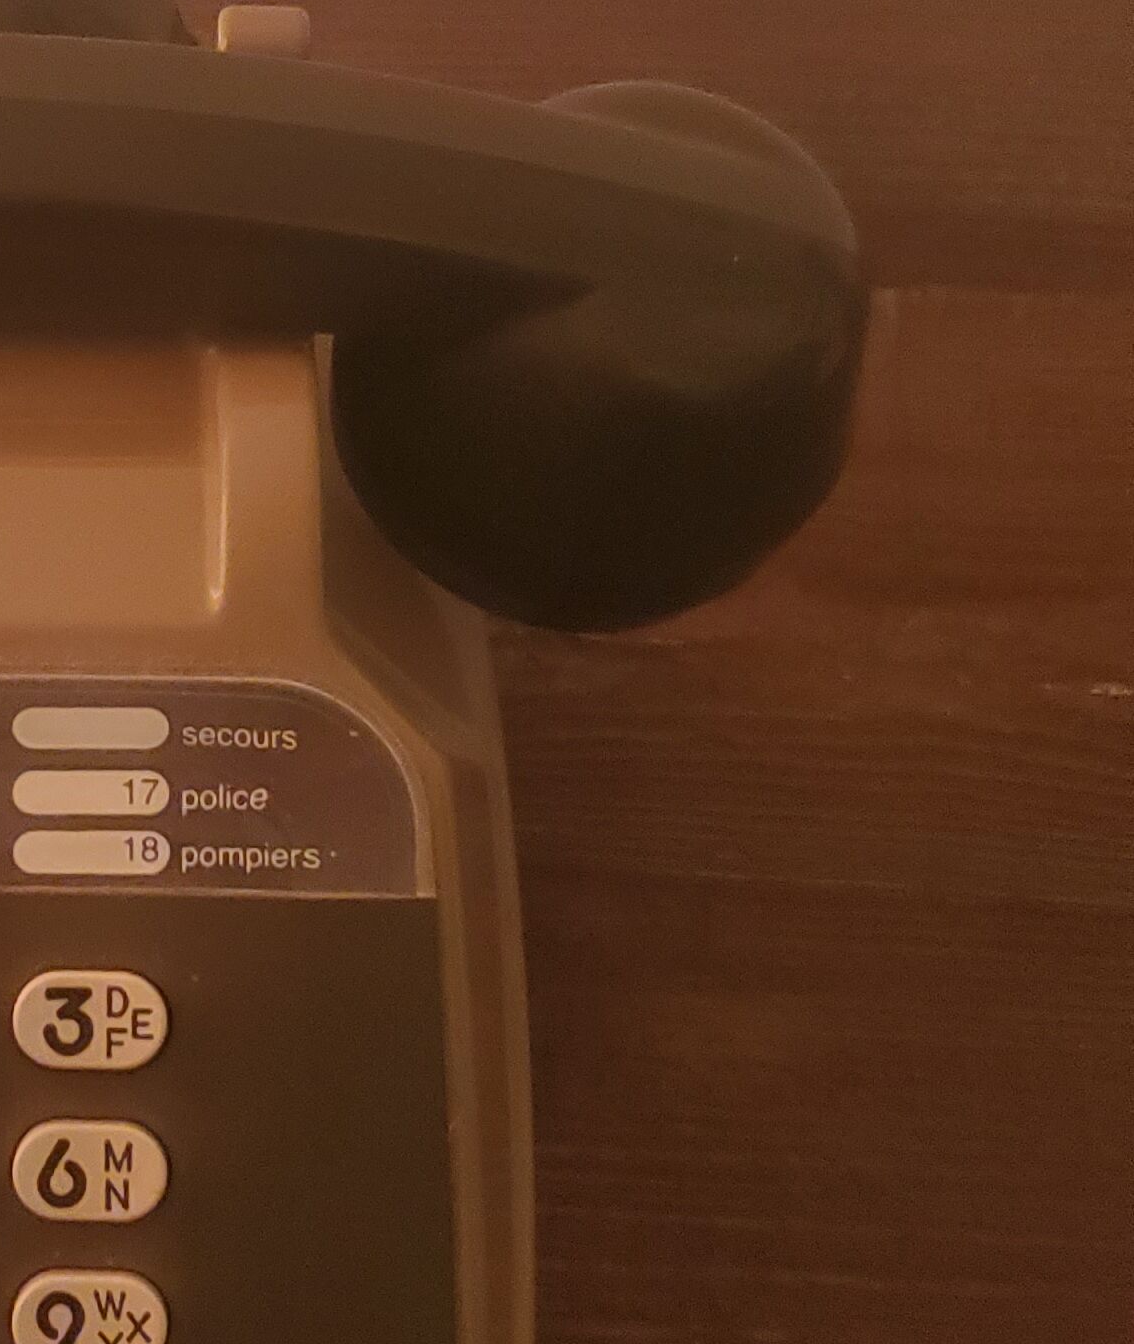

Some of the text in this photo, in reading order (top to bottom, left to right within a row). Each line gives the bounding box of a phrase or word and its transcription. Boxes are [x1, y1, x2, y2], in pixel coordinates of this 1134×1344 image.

[181, 725, 298, 750] secours
[123, 779, 268, 816] 17 police
[125, 836, 321, 874] 18 pompiers
[43, 987, 94, 1056] 3
[37, 1138, 87, 1208] 6
